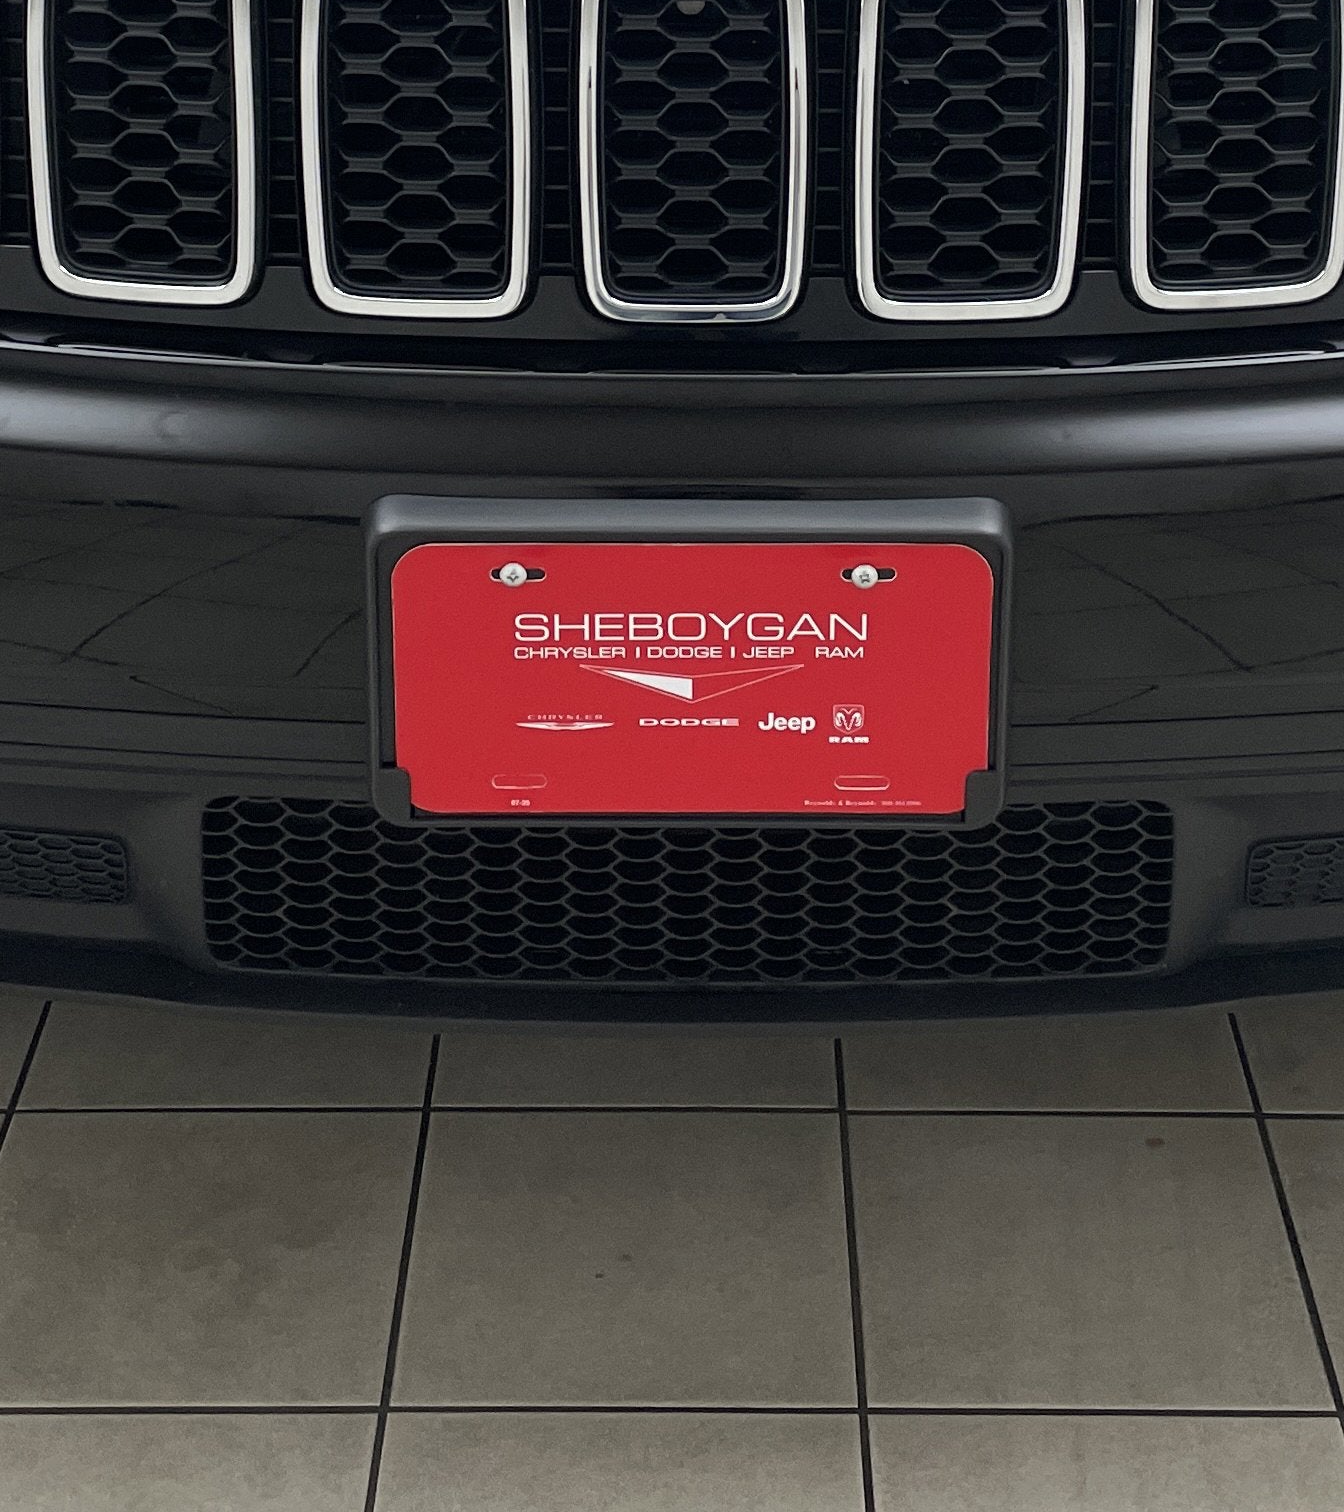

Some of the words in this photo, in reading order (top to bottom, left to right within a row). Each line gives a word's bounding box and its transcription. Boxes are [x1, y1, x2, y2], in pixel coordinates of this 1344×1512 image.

[513, 612, 868, 642] SHEBOYGAN
[513, 646, 626, 660] CHRYSLER
[647, 646, 723, 660] DODGE
[742, 646, 795, 660] JEEP
[815, 646, 865, 660] RAM
[638, 718, 740, 727] DODGE
[758, 712, 816, 735] Jeep
[828, 736, 870, 744] RAM
